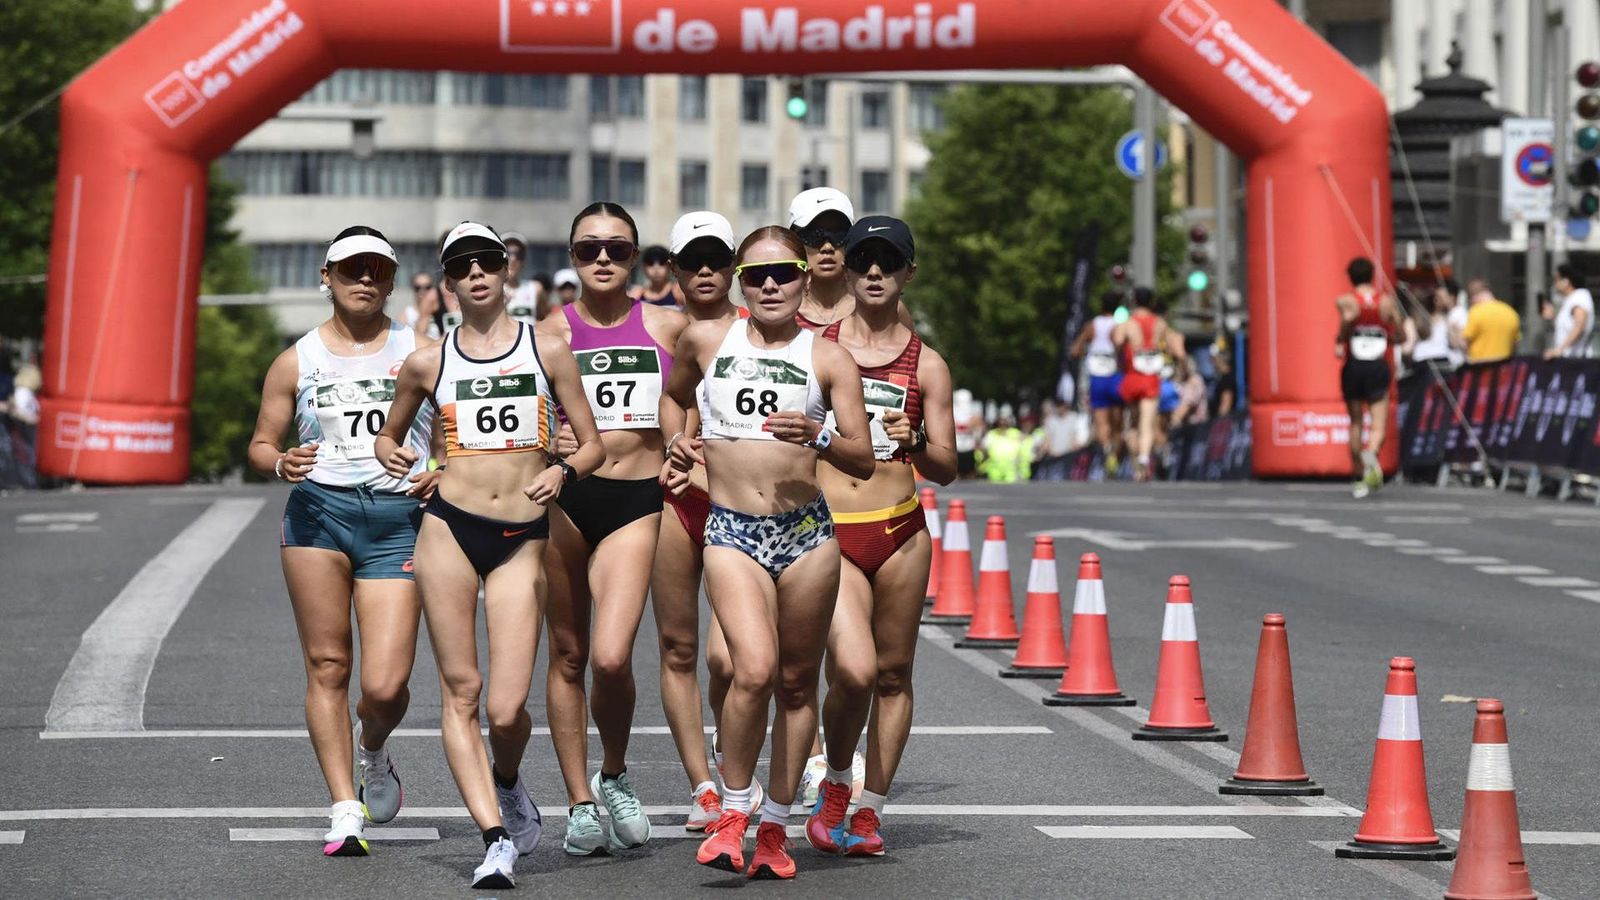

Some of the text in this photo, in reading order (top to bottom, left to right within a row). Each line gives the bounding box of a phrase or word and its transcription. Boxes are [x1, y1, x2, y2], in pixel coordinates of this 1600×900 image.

[184, 0, 287, 80] Comunidad
[633, 3, 976, 53] de Madrid
[202, 12, 304, 98] de Madrid
[1212, 20, 1313, 106] Comunidad
[1195, 39, 1297, 124] de Madrid
[476, 405, 519, 434] 66
[596, 381, 636, 408] 67
[736, 388, 778, 417] 68
[344, 409, 386, 437] 70
